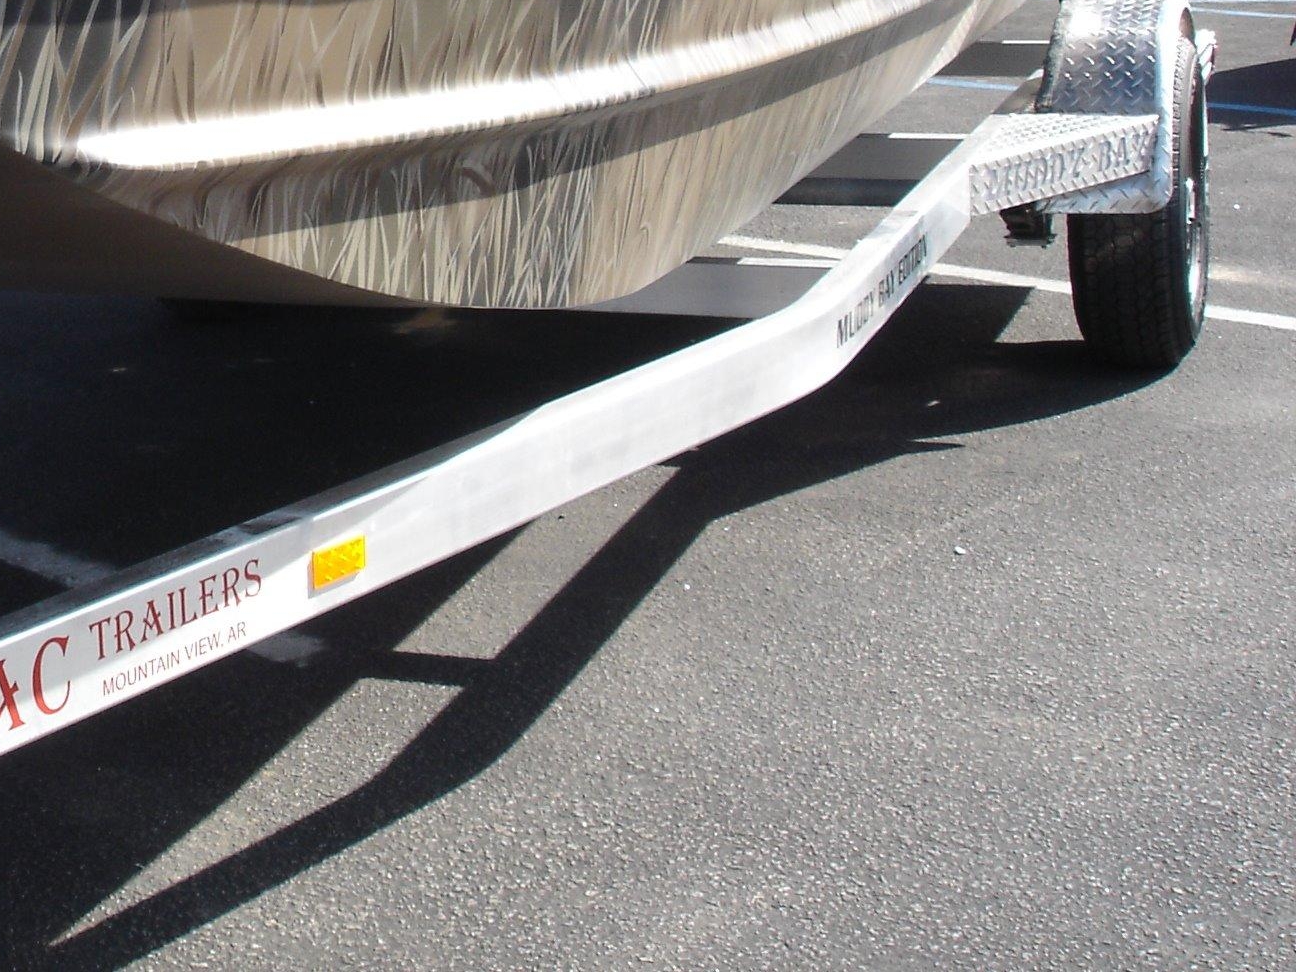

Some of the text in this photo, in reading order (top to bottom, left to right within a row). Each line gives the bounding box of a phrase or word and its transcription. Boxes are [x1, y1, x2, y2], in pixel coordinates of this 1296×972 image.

[836, 232, 928, 348] MUDDY BAY EDITION
[89, 558, 262, 660] TRAILERS
[102, 649, 181, 696] MOUNTAIN
[227, 621, 247, 643] AR
